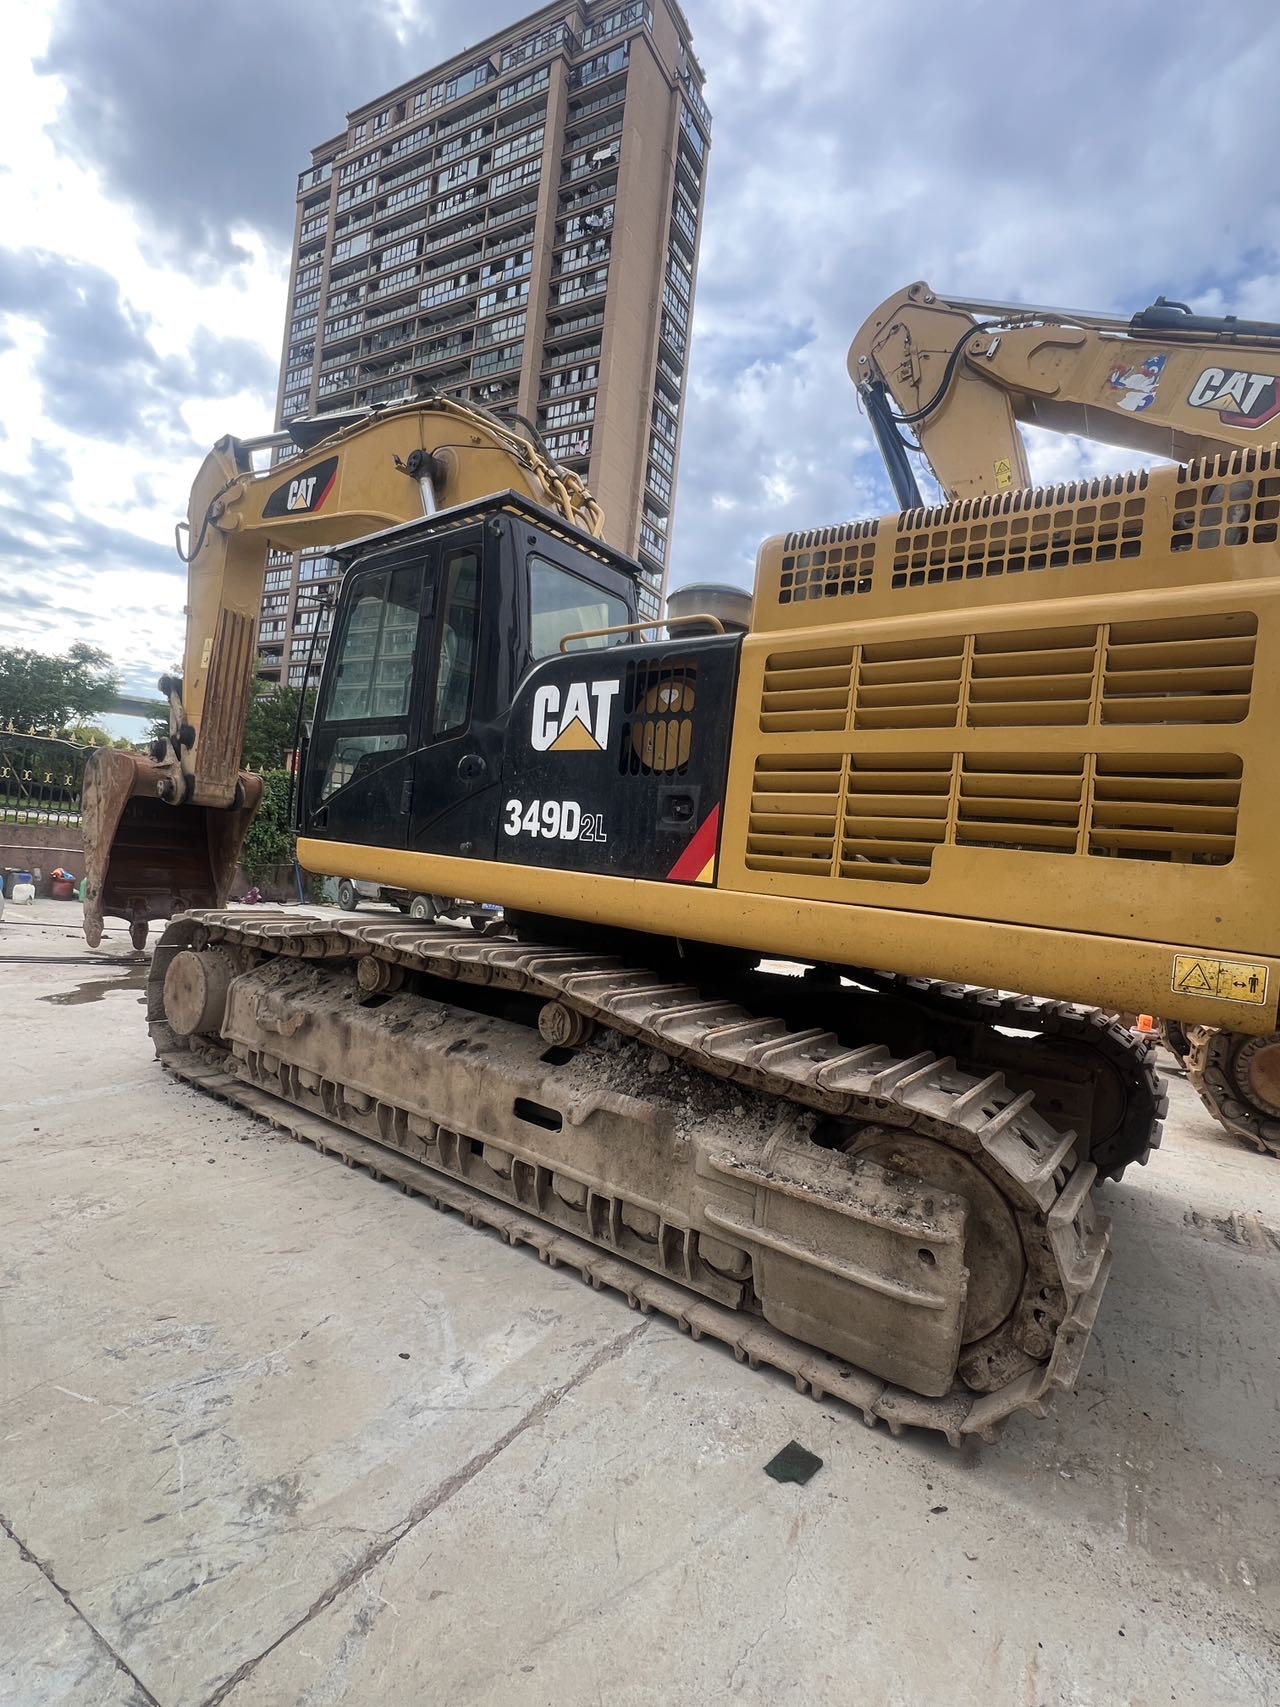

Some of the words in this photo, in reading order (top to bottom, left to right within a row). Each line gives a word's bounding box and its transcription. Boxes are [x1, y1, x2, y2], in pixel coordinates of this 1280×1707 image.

[1189, 367, 1275, 414] CAT
[286, 477, 317, 510] CAT
[531, 680, 620, 751] CAT
